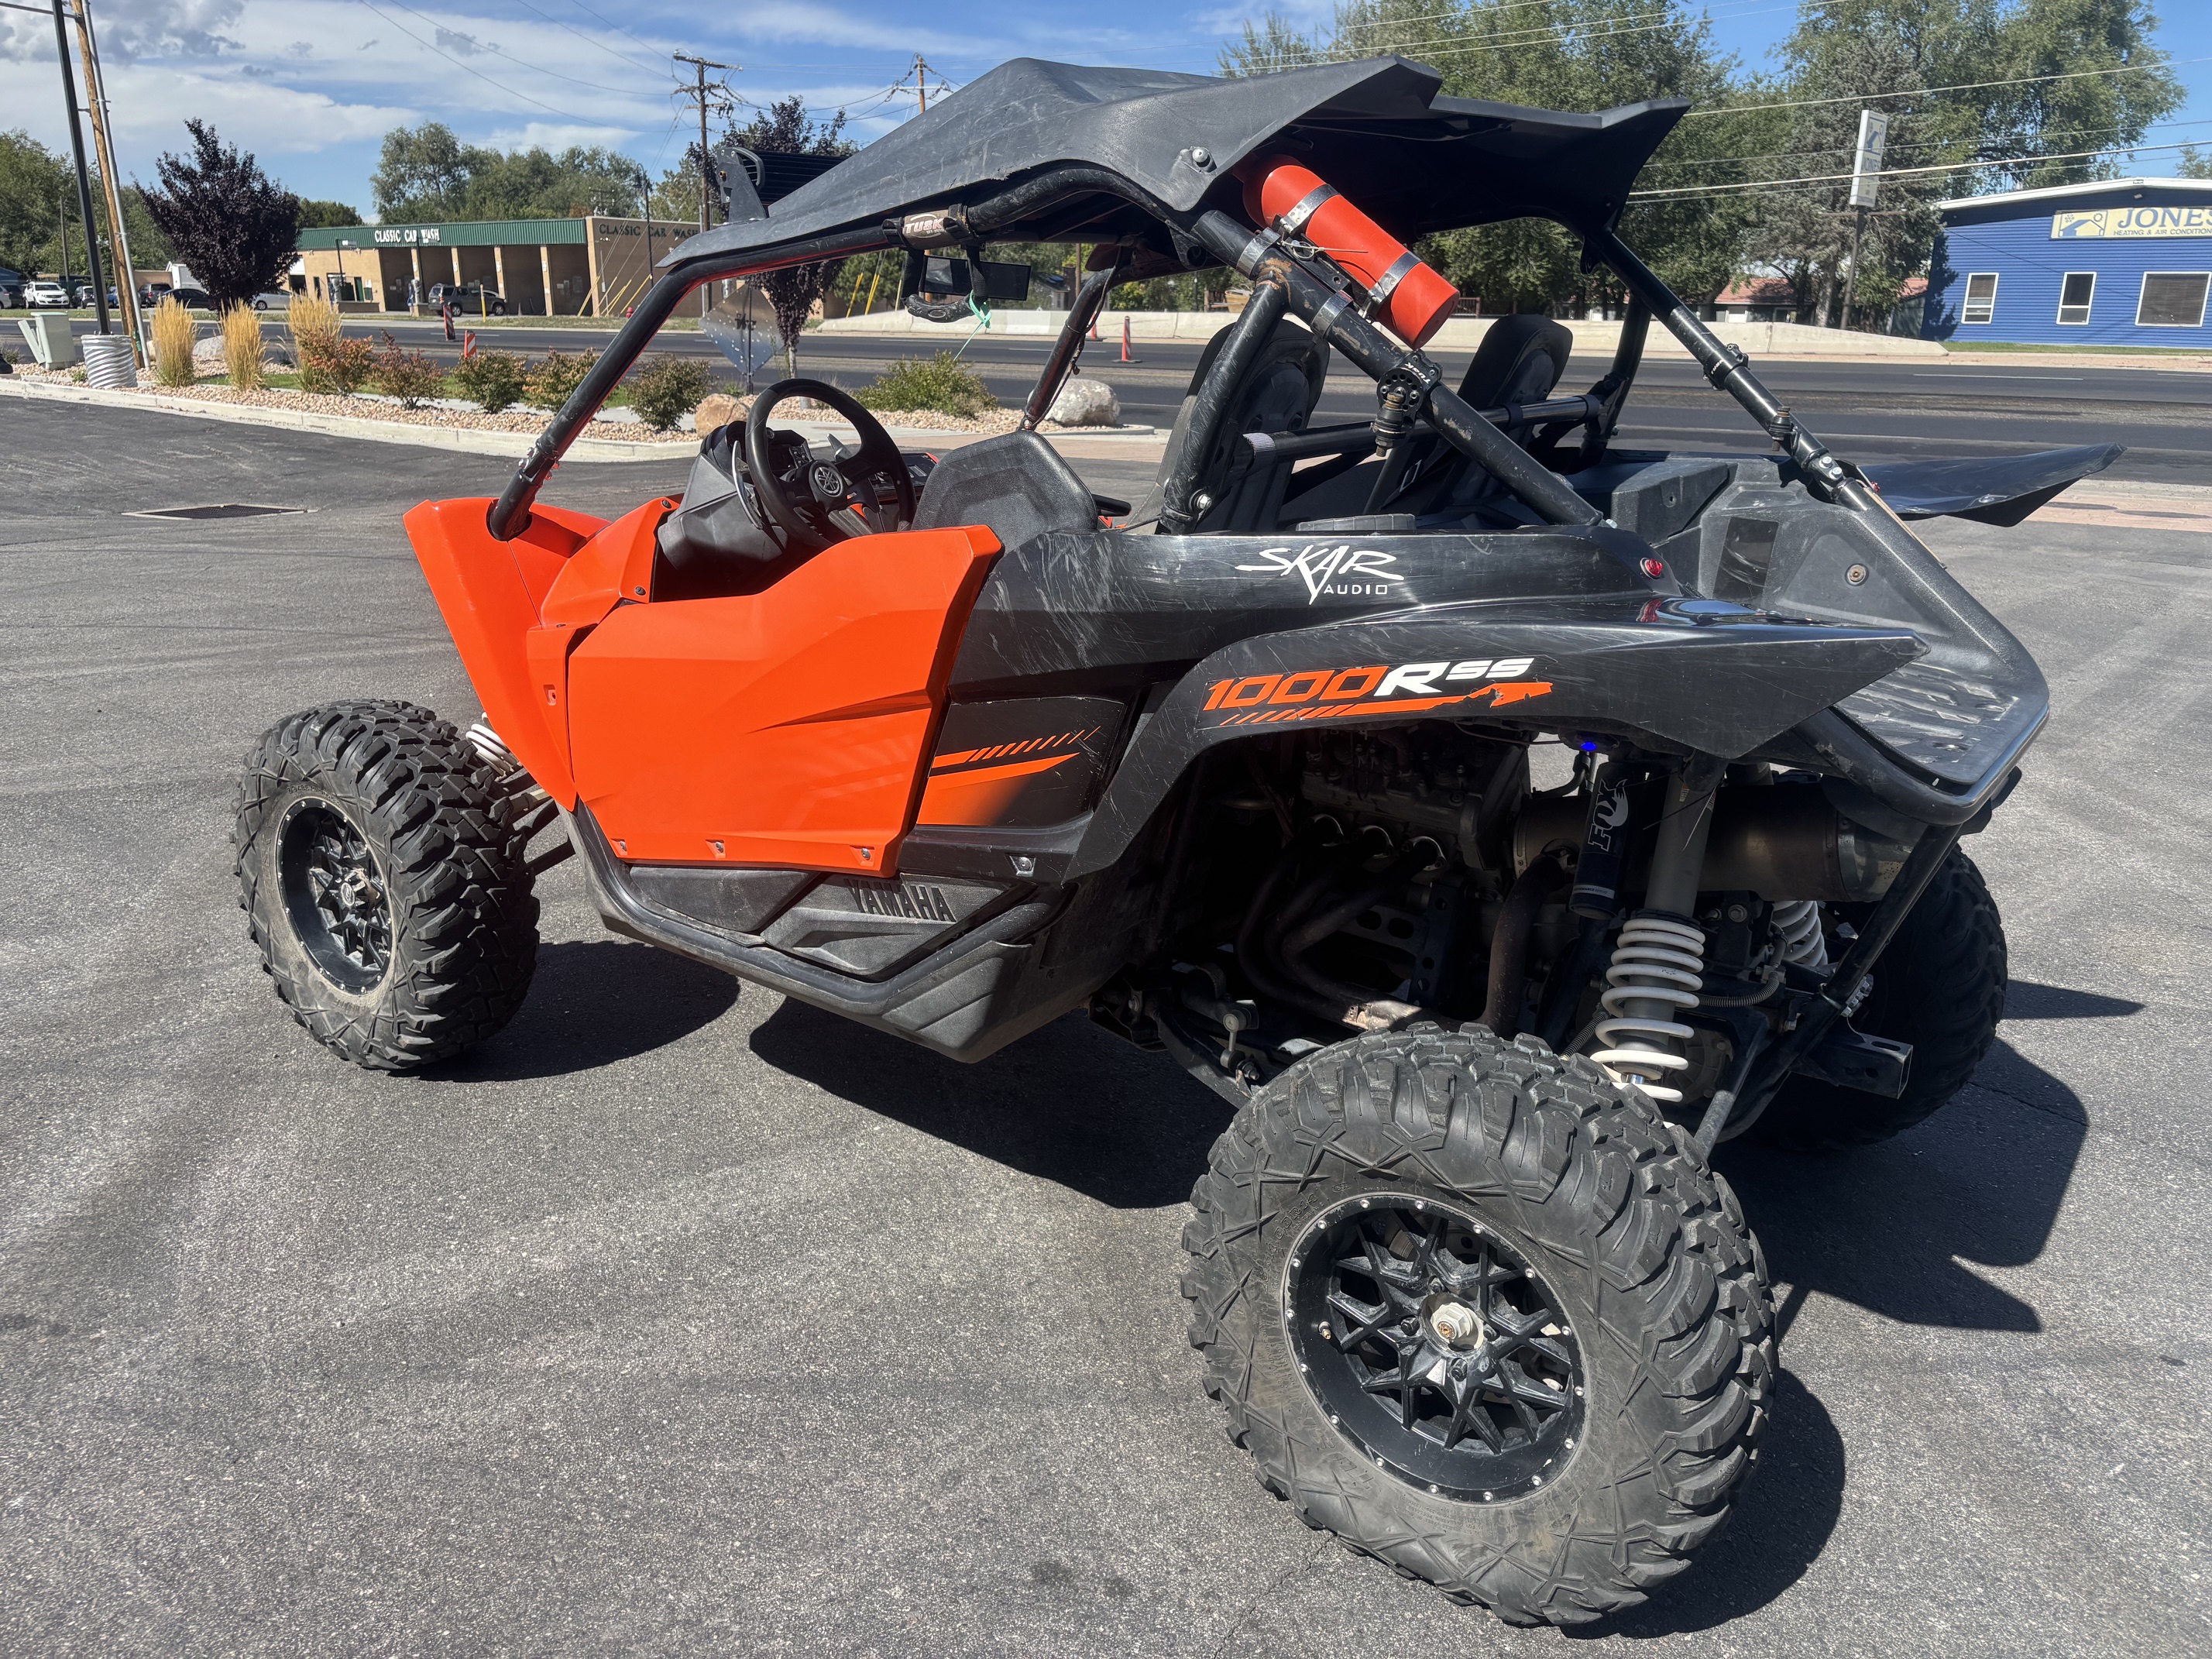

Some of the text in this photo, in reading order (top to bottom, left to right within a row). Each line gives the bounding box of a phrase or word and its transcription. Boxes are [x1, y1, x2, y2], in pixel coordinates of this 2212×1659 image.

[375, 229, 401, 243] CLASSIC
[421, 228, 440, 242] WASH
[599, 224, 641, 236] CLASSIC
[649, 227, 667, 238] CAR
[905, 218, 945, 234] TUSK
[1404, 362, 1431, 384] TUSK
[1235, 544, 1404, 605] SKAR
[1323, 584, 1388, 595] AUDIO
[1588, 778, 1623, 852] FOX
[843, 878, 957, 922] YAMAHA
